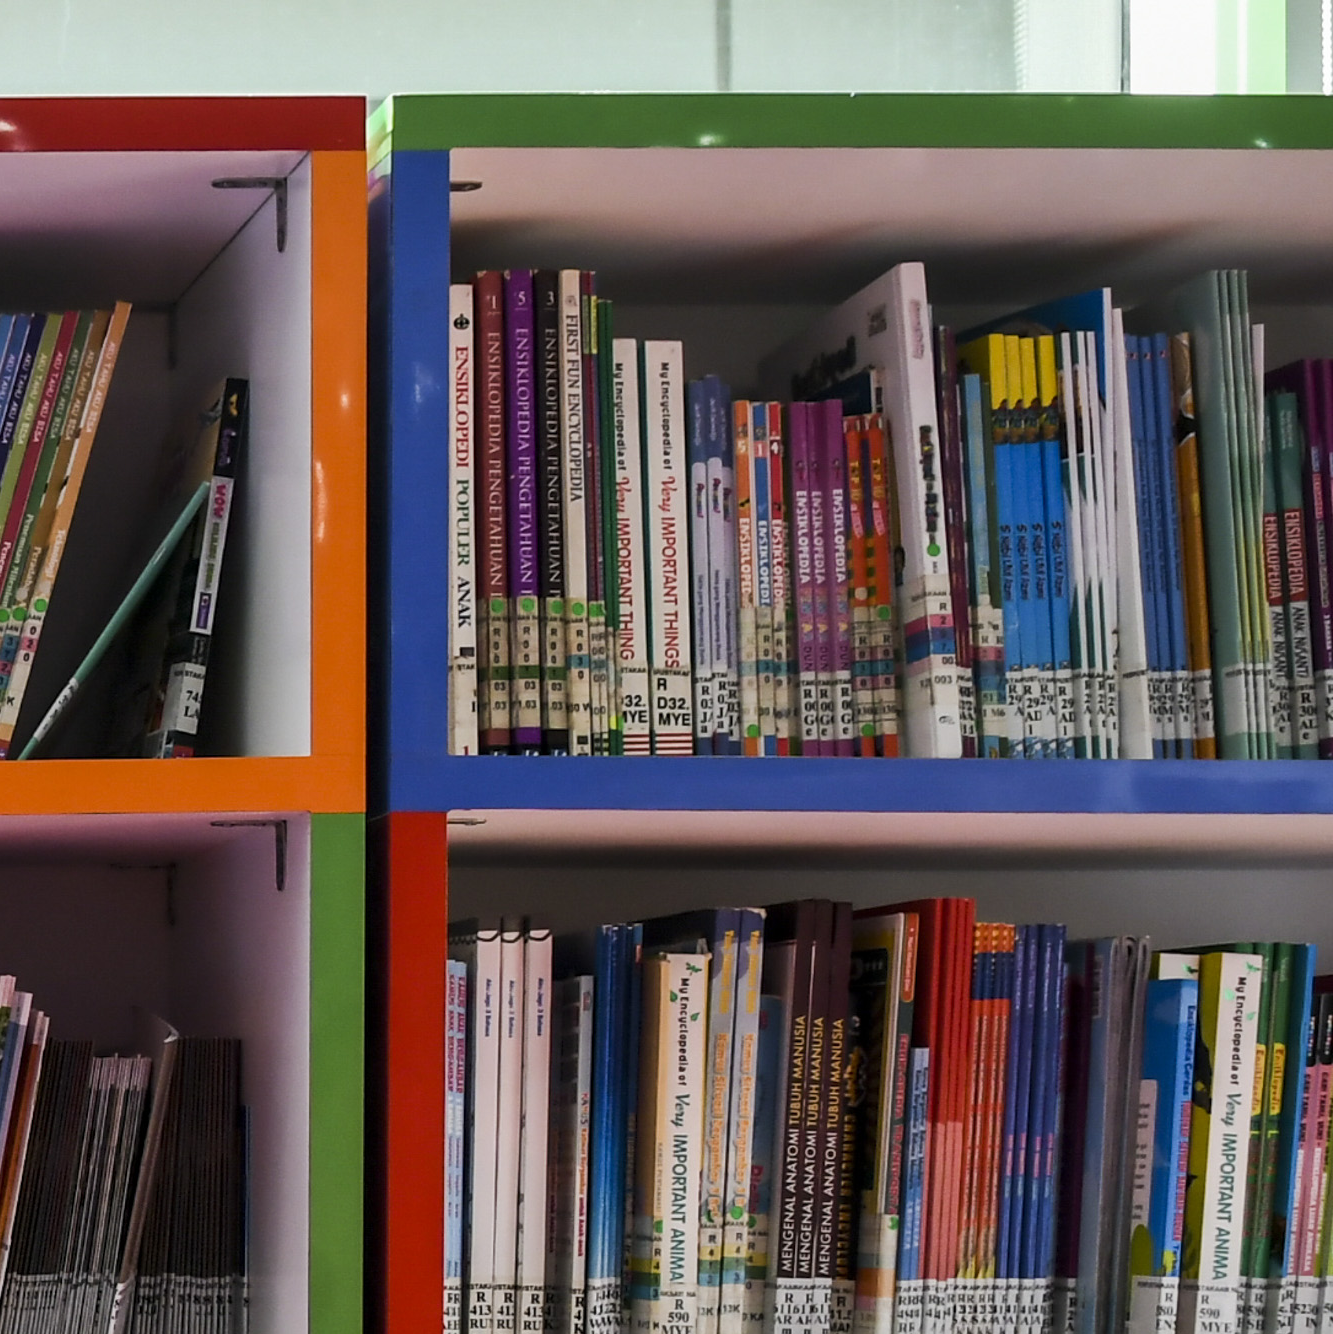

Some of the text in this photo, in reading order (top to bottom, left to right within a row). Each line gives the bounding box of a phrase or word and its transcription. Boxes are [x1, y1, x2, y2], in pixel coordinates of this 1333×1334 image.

[518, 291, 526, 304] 5
[659, 362, 670, 378] My
[566, 315, 583, 502] FIRST FUN ENCYCLOPEDIA
[661, 382, 673, 457] Encyclopedia
[455, 346, 472, 628] ENSIKLOPEDI POPULER ANAK
[487, 332, 503, 587] ENSIKLOPEDIA PENGETAHUAN
[516, 328, 533, 582] ENSIKLOPEDIA PENGETAHUAN
[213, 483, 228, 518] WOW
[658, 477, 678, 513] Very
[661, 517, 679, 606] IMPORTANT
[796, 490, 811, 584] ENSIKLOPEDIA
[811, 491, 826, 584] ENSIKLOPEDIA
[833, 489, 847, 583] ENSIKLOPEDIA
[1263, 515, 1282, 598] ENSIKLOPEDIA
[1284, 511, 1304, 594] ENSIKLOPEDIA
[664, 610, 680, 668] THINGS
[657, 678, 667, 690] R
[657, 697, 690, 710] D32.
[658, 713, 691, 726] MYE
[680, 978, 690, 994] My
[1235, 977, 1247, 992] My
[677, 997, 689, 1073] Encyclopedia
[1231, 995, 1246, 1072] Encyclopedia
[671, 1094, 690, 1128] Very
[1220, 1093, 1242, 1126] Very
[781, 1015, 807, 1272] MENGENAL ANATOMI TUBUH MANUSIA
[799, 1017, 824, 1274] MENGENAL ANATOMI TUBUH MANUSIA
[670, 1134, 689, 1224] IMPORTANT
[1216, 1133, 1238, 1223] IMPORTANT
[667, 1312, 689, 1323] 590
[674, 1299, 684, 1310] R
[1199, 1309, 1220, 1319] 590
[1200, 1322, 1232, 1333] MYE
[1201, 1295, 1210, 1305] R
